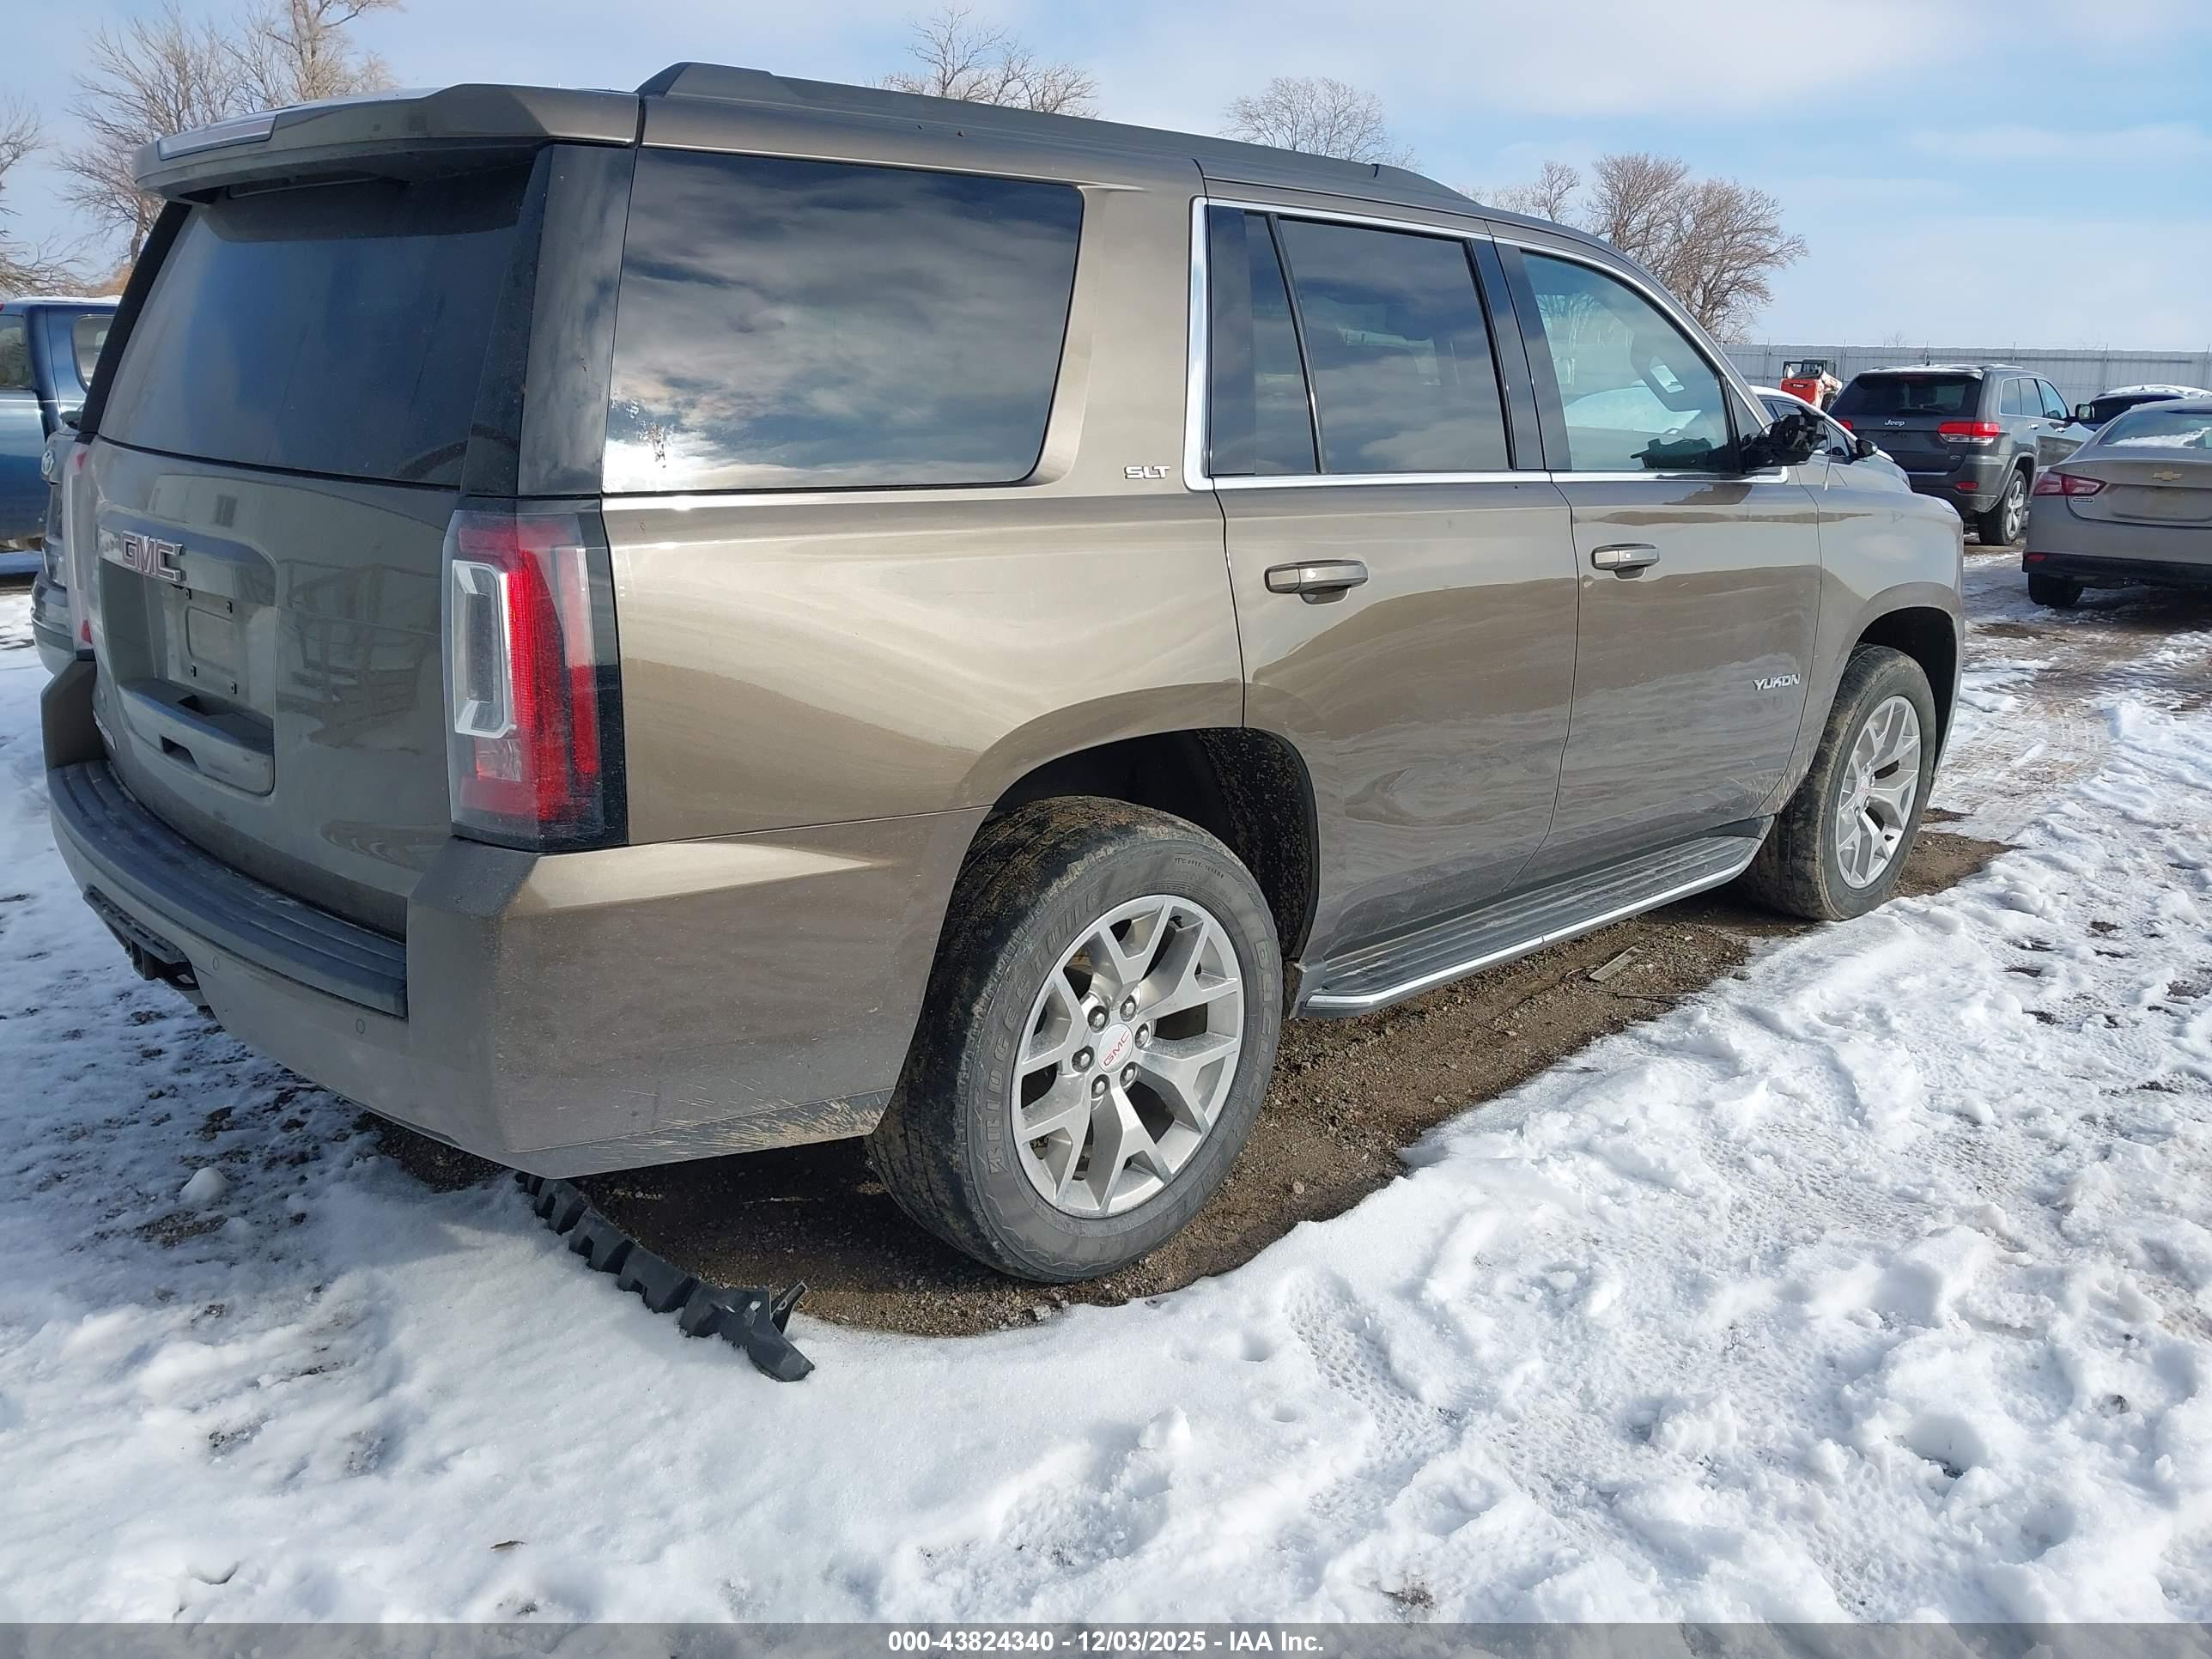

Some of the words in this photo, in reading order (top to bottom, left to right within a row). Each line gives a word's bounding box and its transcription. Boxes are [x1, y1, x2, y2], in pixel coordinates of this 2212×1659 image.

[1884, 419, 1905, 428] Jeep
[1124, 465, 1170, 479] SLT
[122, 530, 185, 582] GMC
[1752, 673, 1800, 690] YUKON
[1103, 1030, 1129, 1066] GMC
